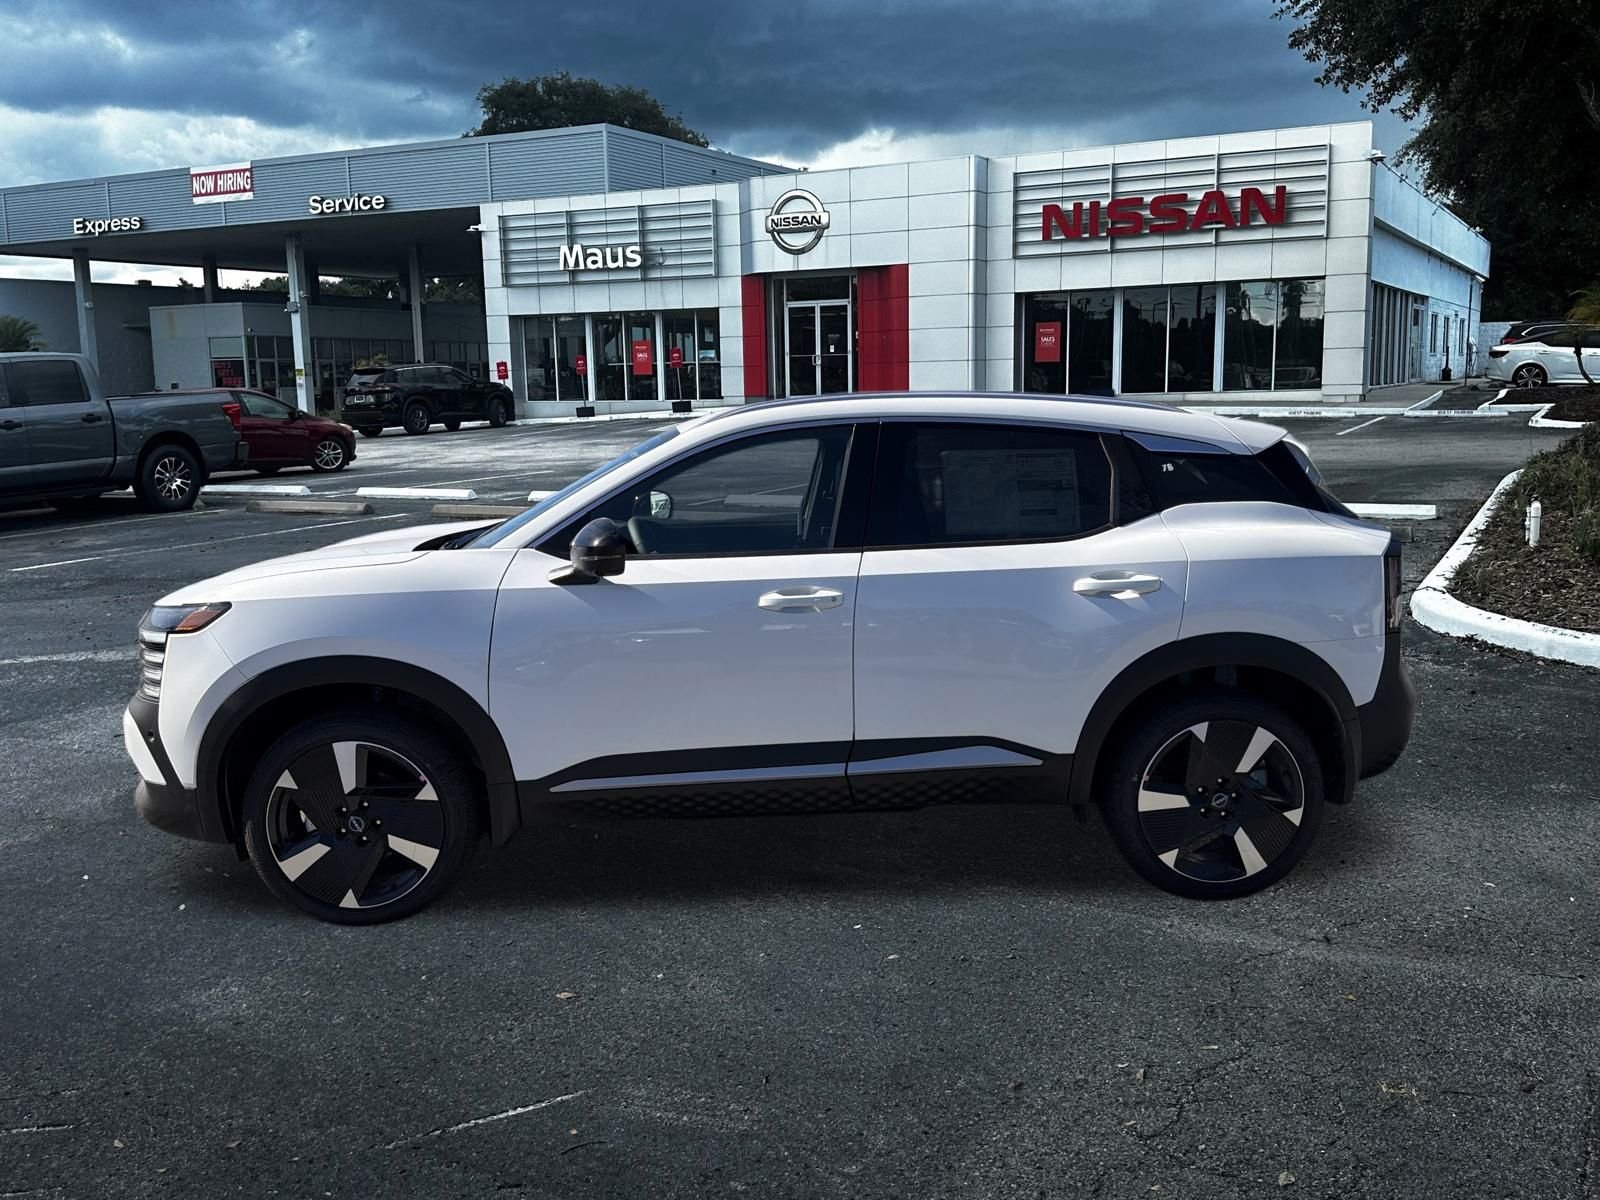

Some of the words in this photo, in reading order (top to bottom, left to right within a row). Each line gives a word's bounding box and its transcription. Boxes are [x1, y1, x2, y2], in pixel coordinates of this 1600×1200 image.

[192, 174, 215, 195] NOW
[217, 170, 251, 192] HIRING
[308, 193, 385, 214] Service
[1042, 185, 1287, 241] NISSAN
[73, 216, 142, 237] Express
[770, 215, 822, 229] NISSAN
[559, 243, 642, 271] Maus
